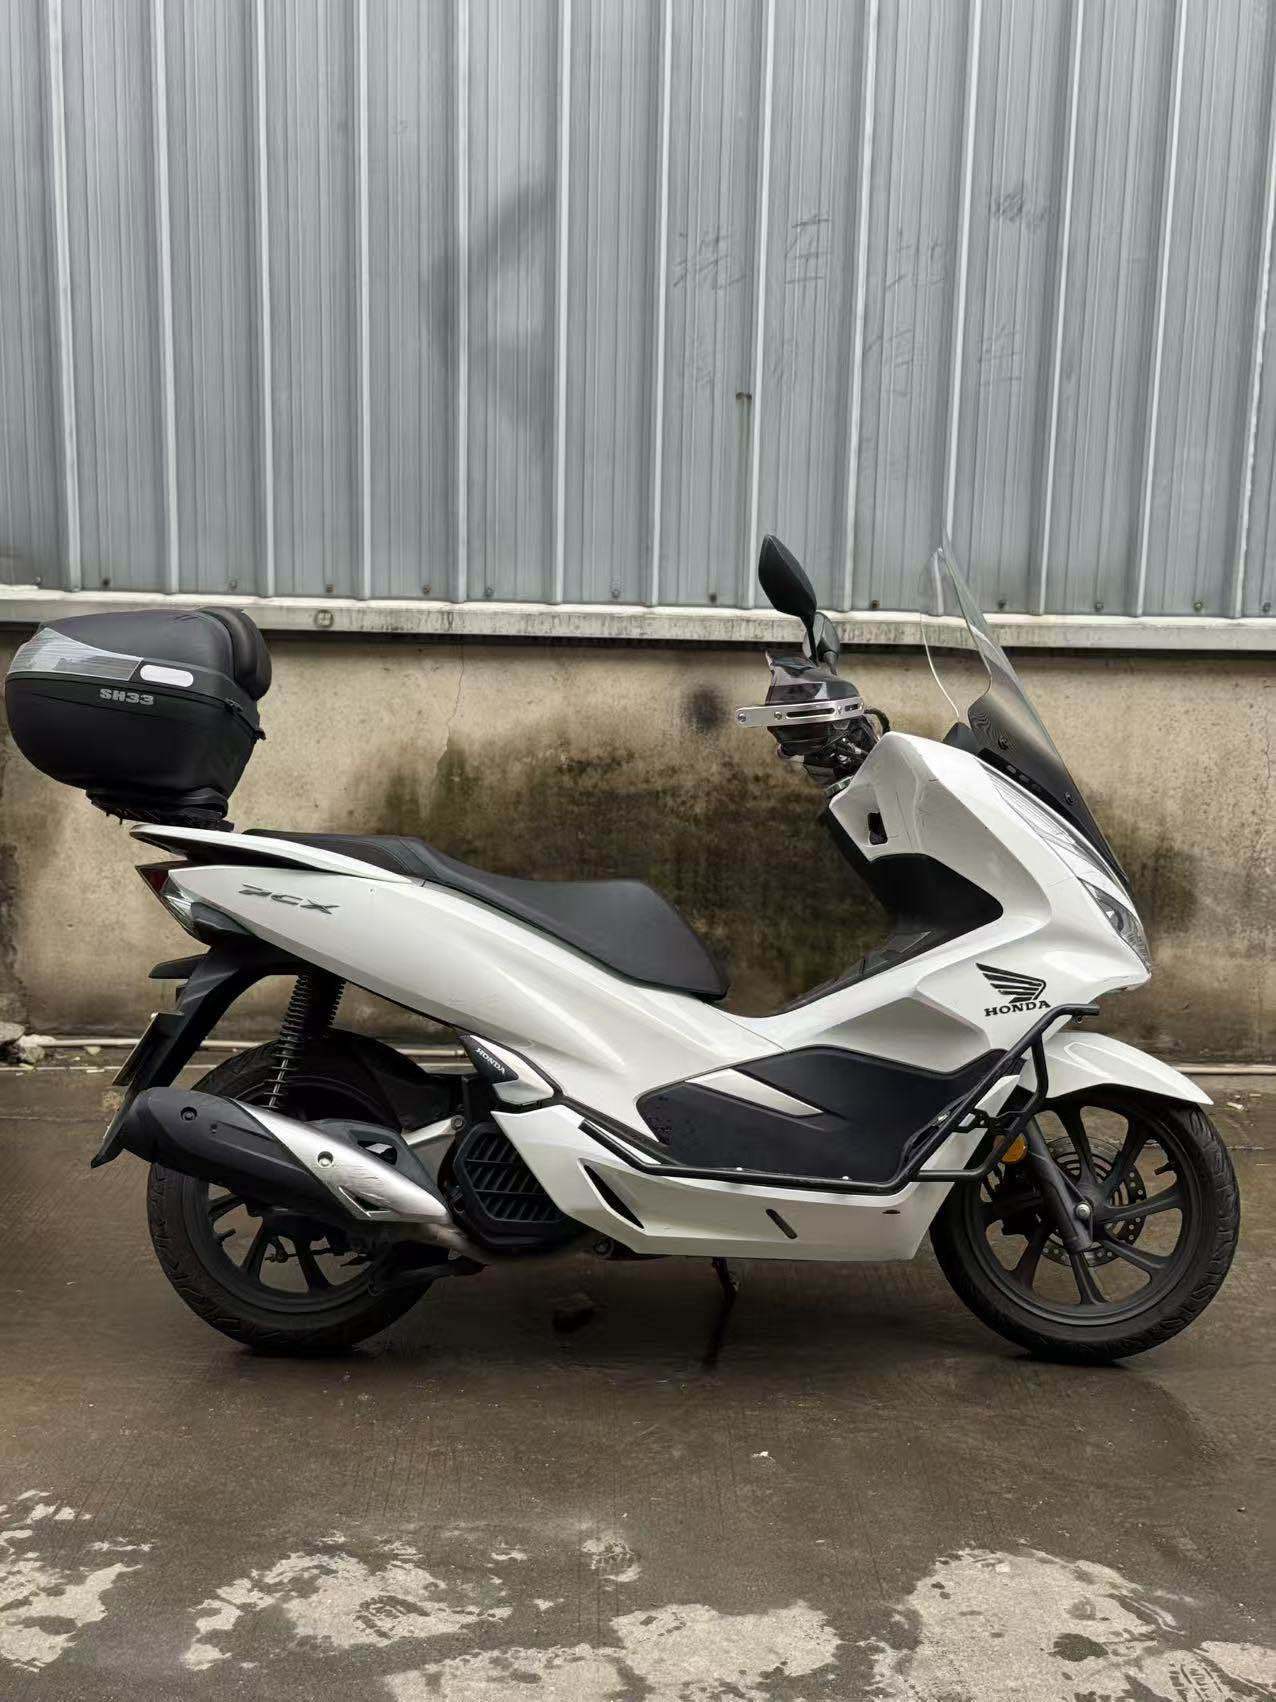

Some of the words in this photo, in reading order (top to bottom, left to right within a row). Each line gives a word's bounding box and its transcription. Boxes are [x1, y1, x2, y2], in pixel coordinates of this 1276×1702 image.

[99, 688, 155, 706] SH33
[984, 1000, 1051, 1016] HONDA
[475, 1048, 506, 1074] HONDA
